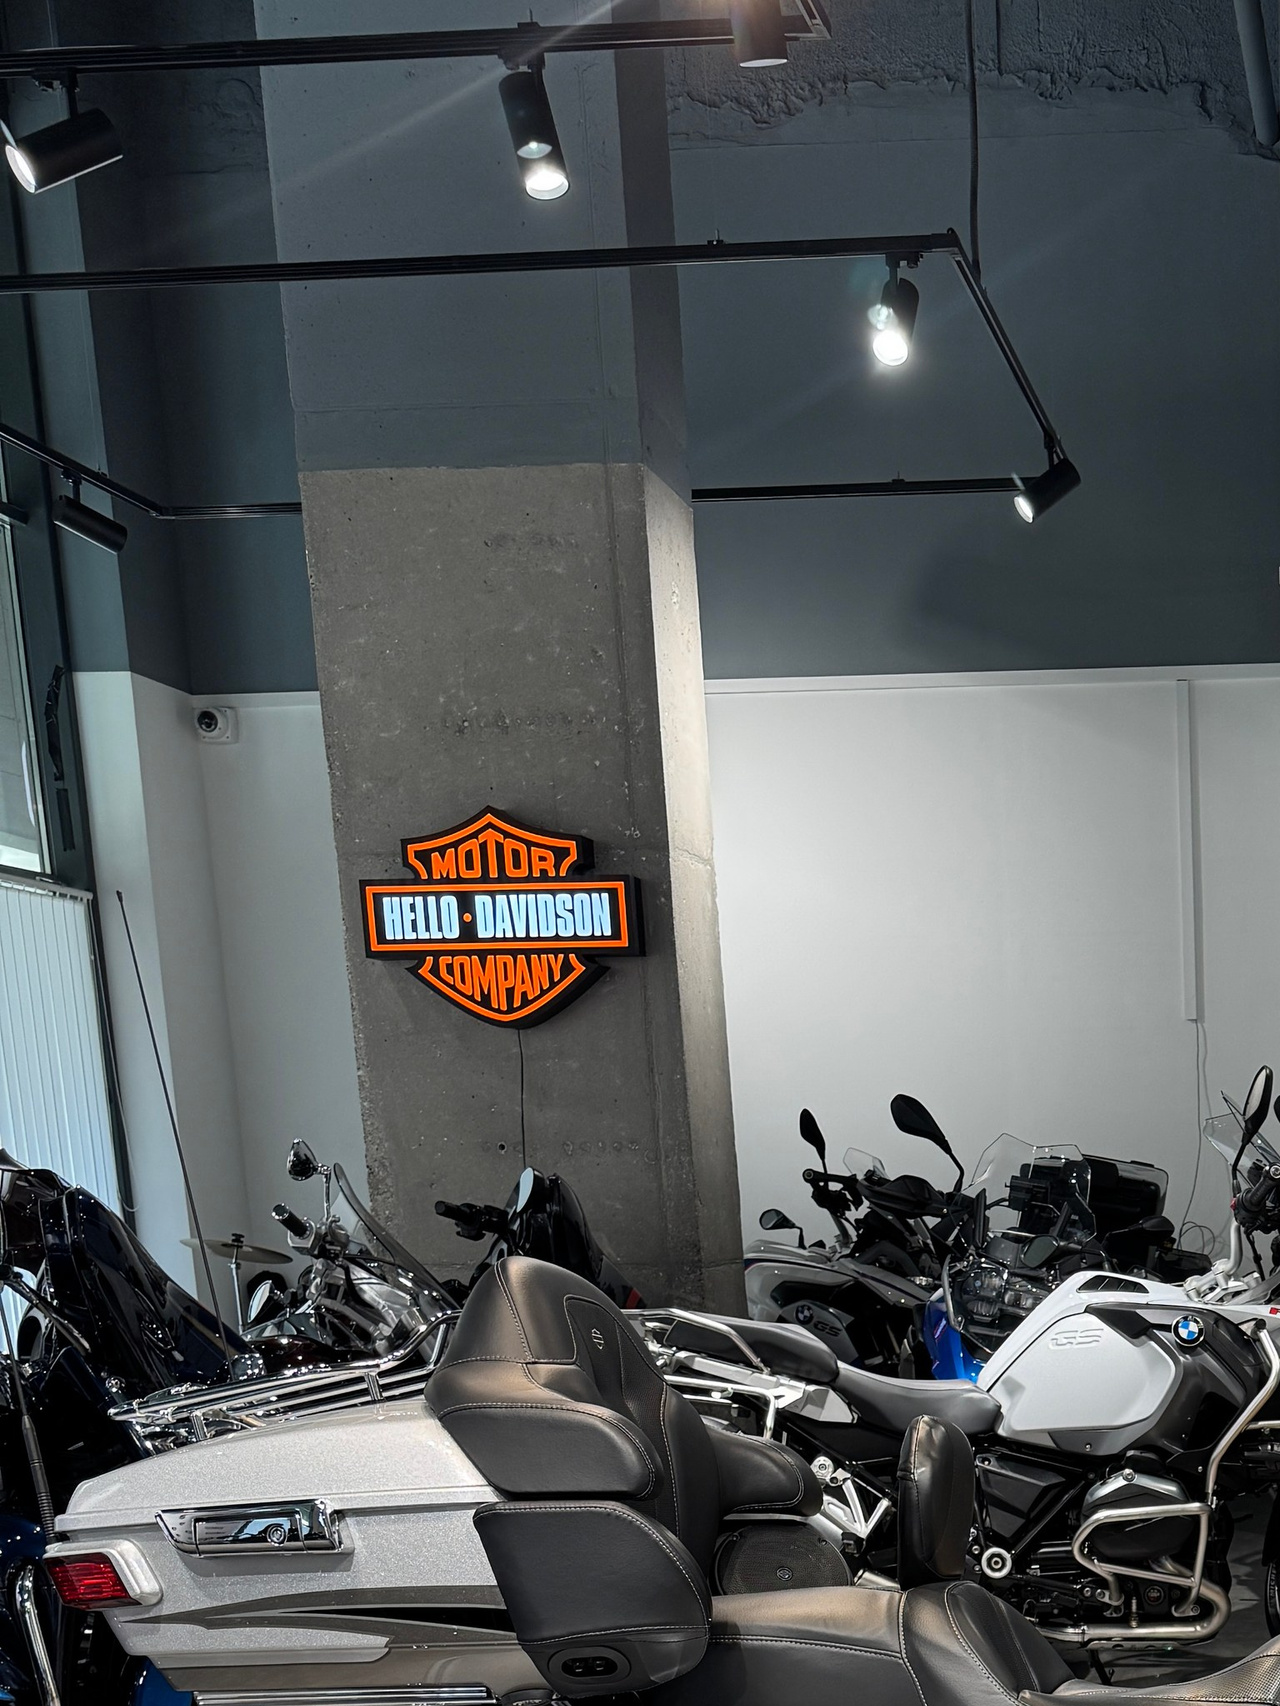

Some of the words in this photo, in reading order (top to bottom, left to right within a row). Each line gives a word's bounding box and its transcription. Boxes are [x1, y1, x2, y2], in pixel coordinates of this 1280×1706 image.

[431, 828, 556, 879] MOTOR
[382, 895, 460, 940] HELLO
[474, 892, 612, 939] DAVIDSON
[438, 953, 565, 1011] COMPANY
[813, 1320, 843, 1337] GS
[1050, 1328, 1104, 1349] GS
